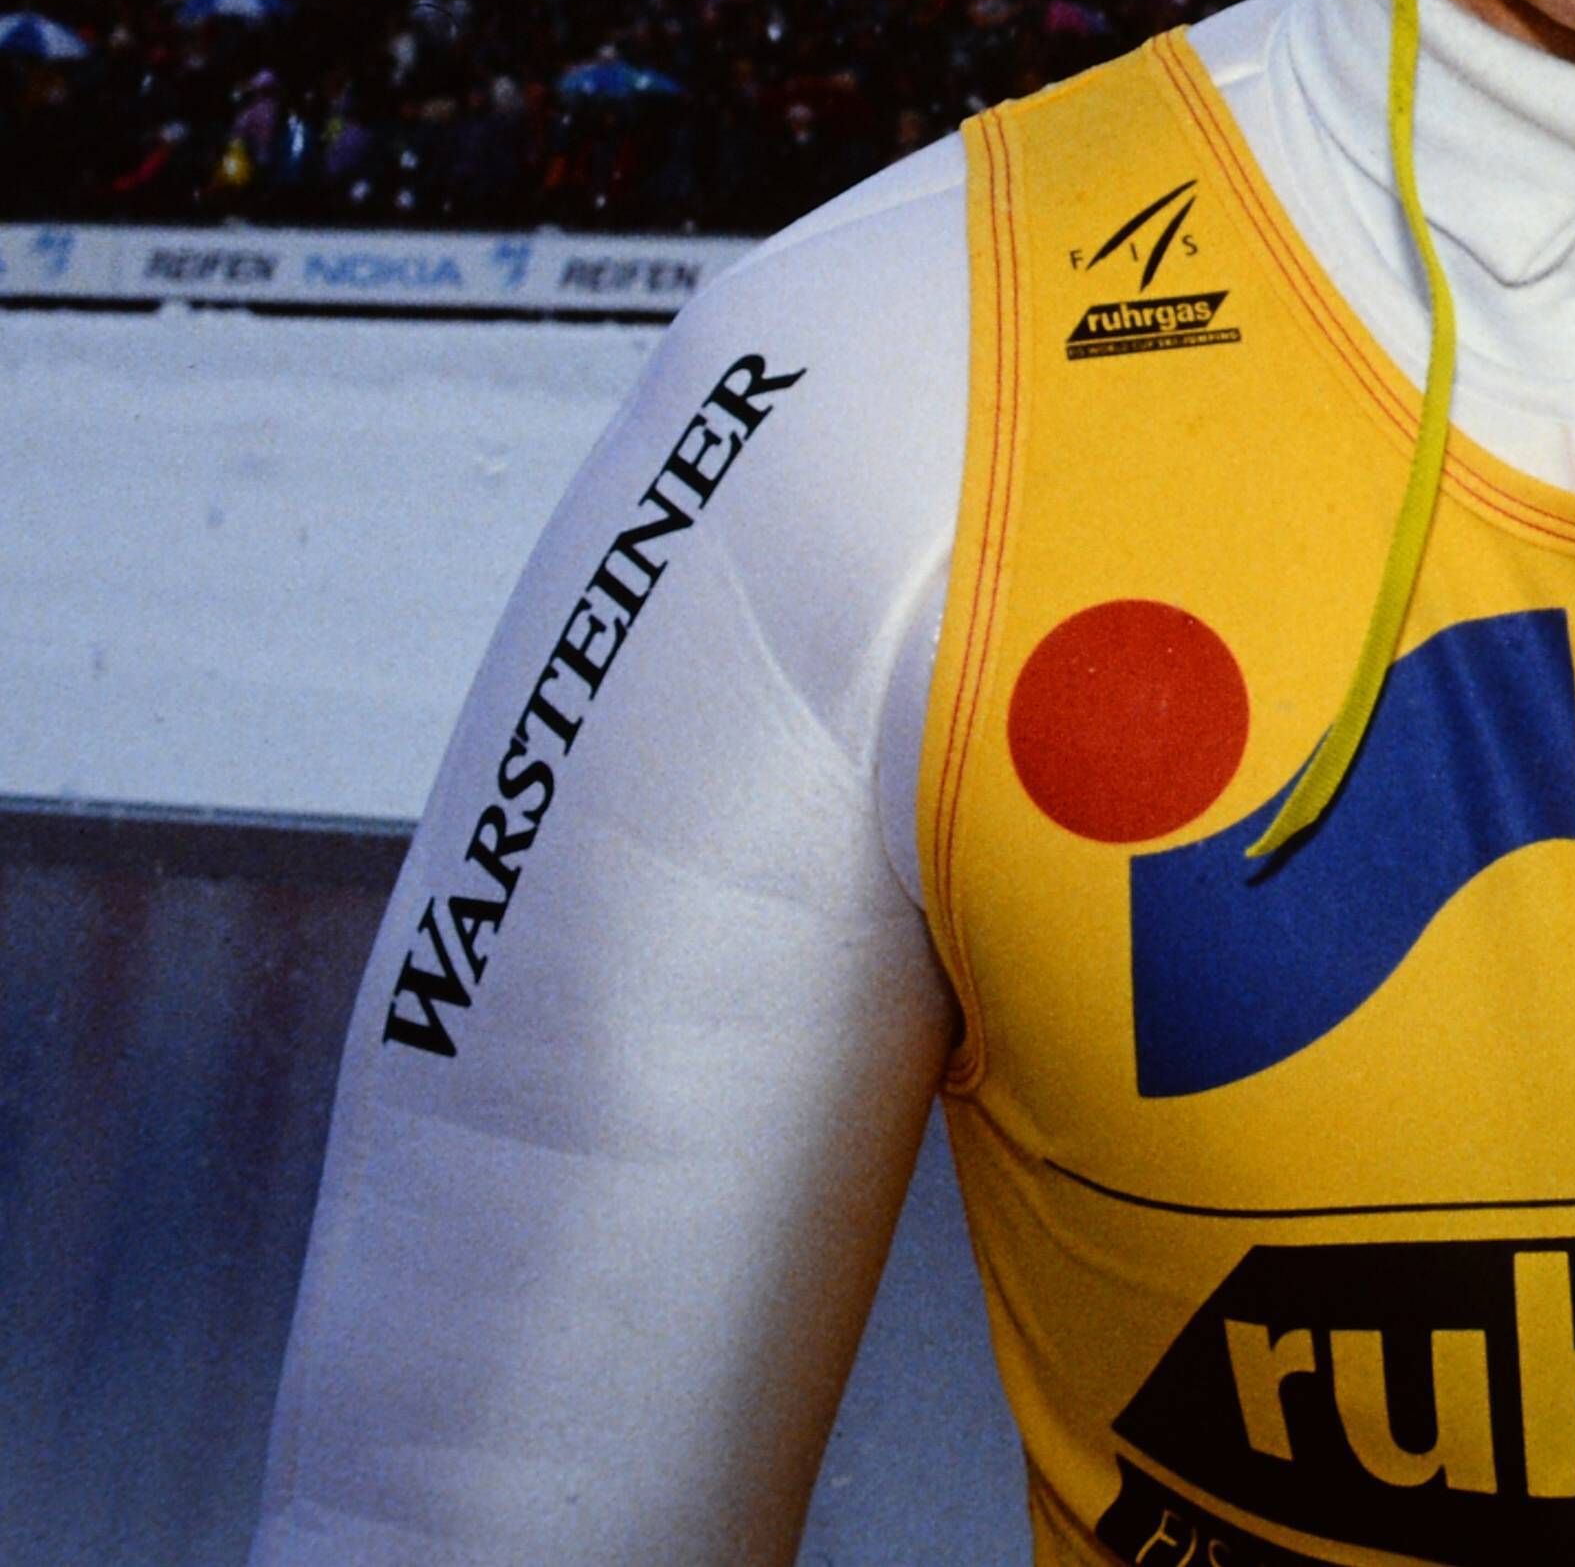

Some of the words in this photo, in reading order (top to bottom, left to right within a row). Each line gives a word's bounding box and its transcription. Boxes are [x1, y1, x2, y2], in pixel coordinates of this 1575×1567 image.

[304, 251, 464, 290] NOKIA
[1086, 300, 1213, 332] ruhrgas
[380, 353, 808, 1059] WARSTEINER
